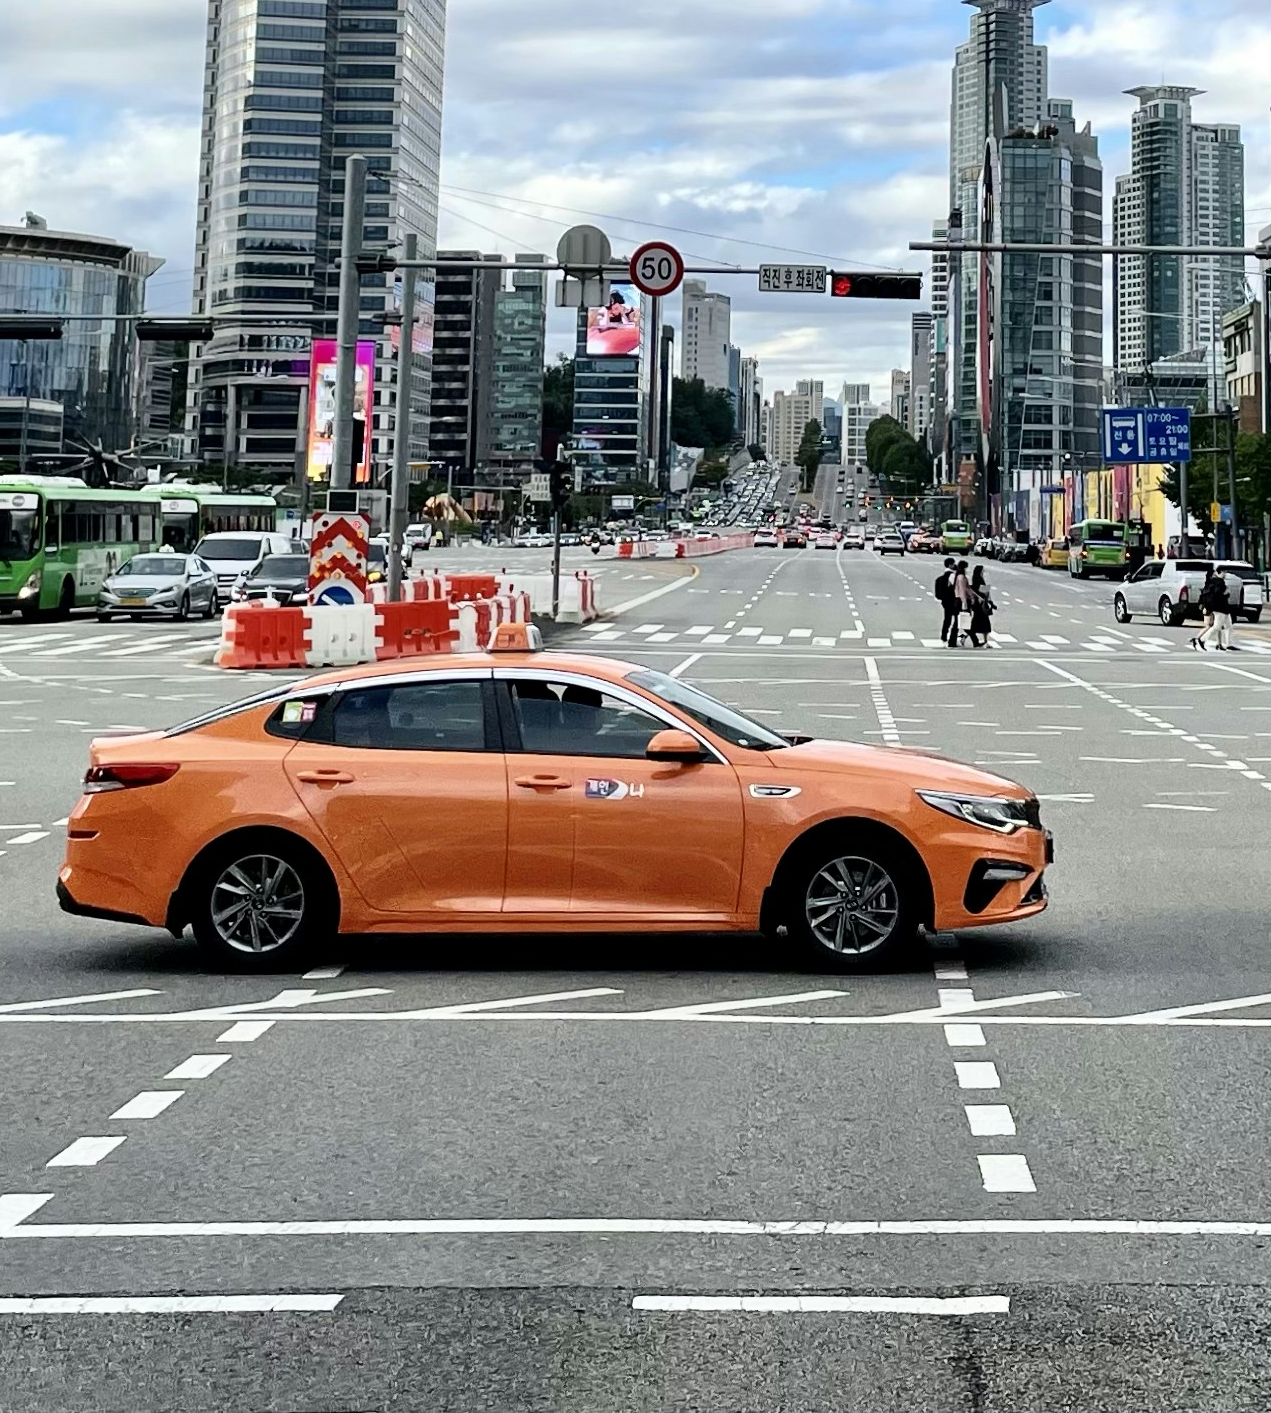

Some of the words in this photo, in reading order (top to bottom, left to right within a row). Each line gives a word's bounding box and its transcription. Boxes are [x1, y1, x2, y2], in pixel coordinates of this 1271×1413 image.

[641, 257, 672, 280] 50
[763, 267, 780, 288] 직진
[784, 268, 792, 289] 후
[796, 269, 824, 290] 좌회전
[1166, 425, 1188, 434] 21:00
